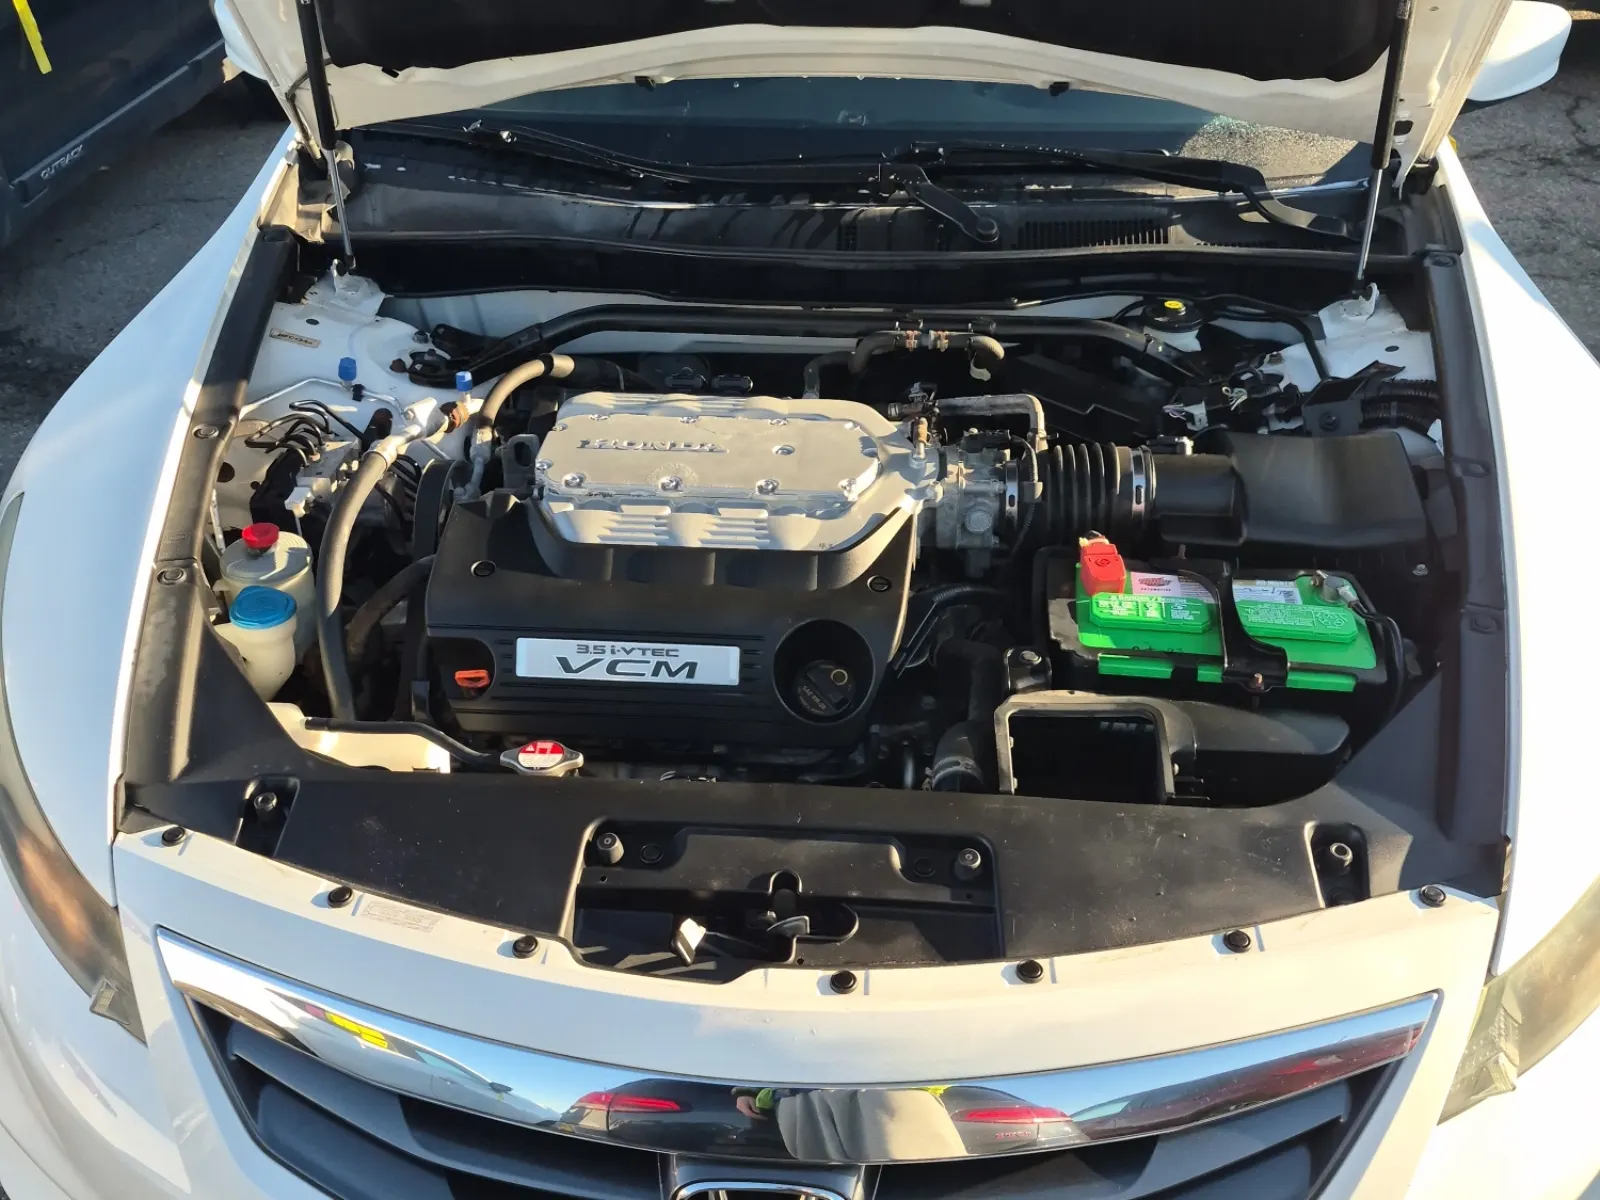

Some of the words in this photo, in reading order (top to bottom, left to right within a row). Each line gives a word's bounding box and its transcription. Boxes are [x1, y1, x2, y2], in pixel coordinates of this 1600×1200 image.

[576, 644, 606, 655] 3.5
[610, 645, 680, 657] i-VTEC
[555, 656, 699, 680] VCM
